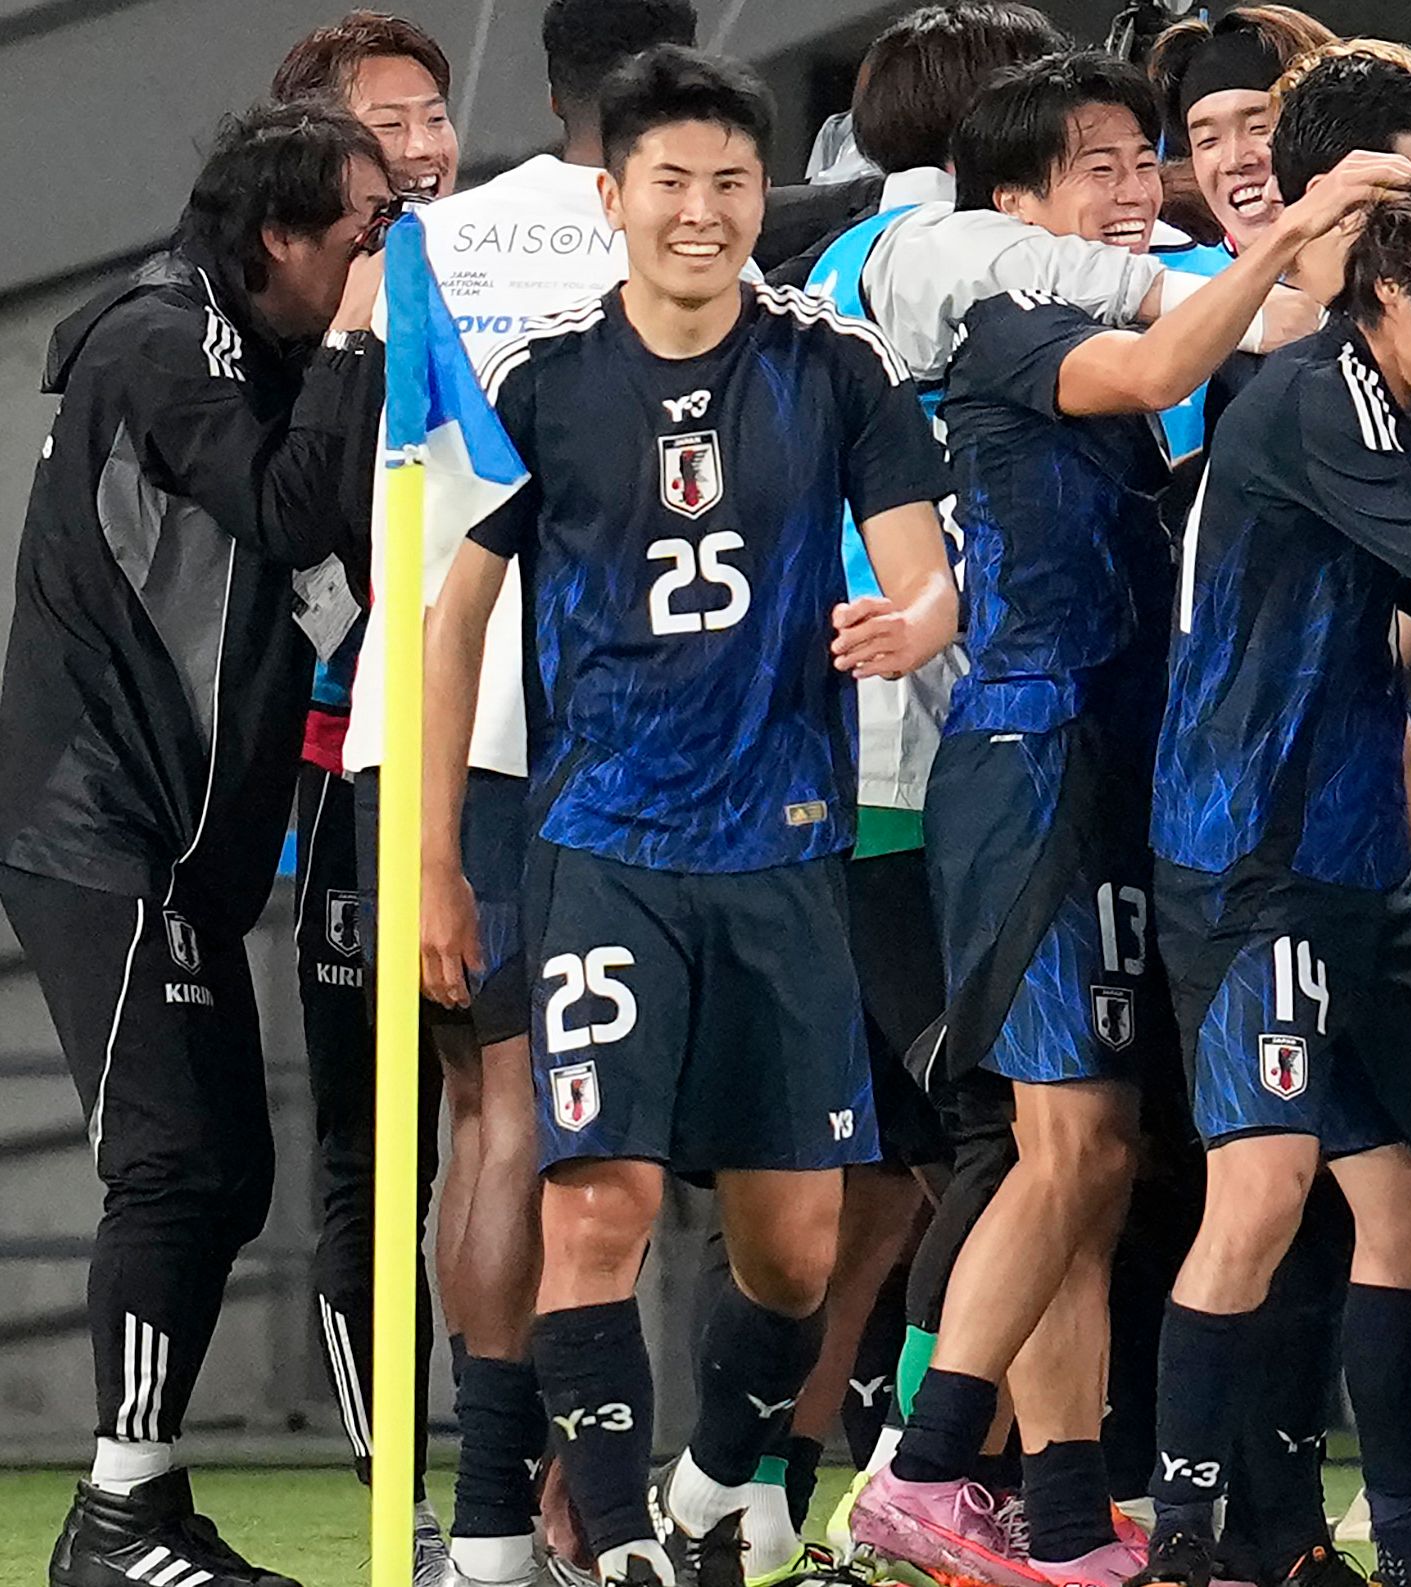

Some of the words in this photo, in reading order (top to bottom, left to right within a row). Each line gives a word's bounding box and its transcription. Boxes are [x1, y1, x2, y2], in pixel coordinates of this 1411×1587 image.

[453, 223, 618, 255] SAISON
[450, 271, 487, 279] JAPAN
[450, 288, 481, 297] TEAM
[662, 389, 712, 423] Y-3
[647, 530, 751, 636] 25
[1097, 882, 1148, 976] 13
[316, 963, 364, 987] KIRI
[1273, 936, 1330, 1035] 14
[542, 946, 638, 1054] 25
[552, 1402, 634, 1441] Y-3
[1160, 1451, 1221, 1488] Y-3
